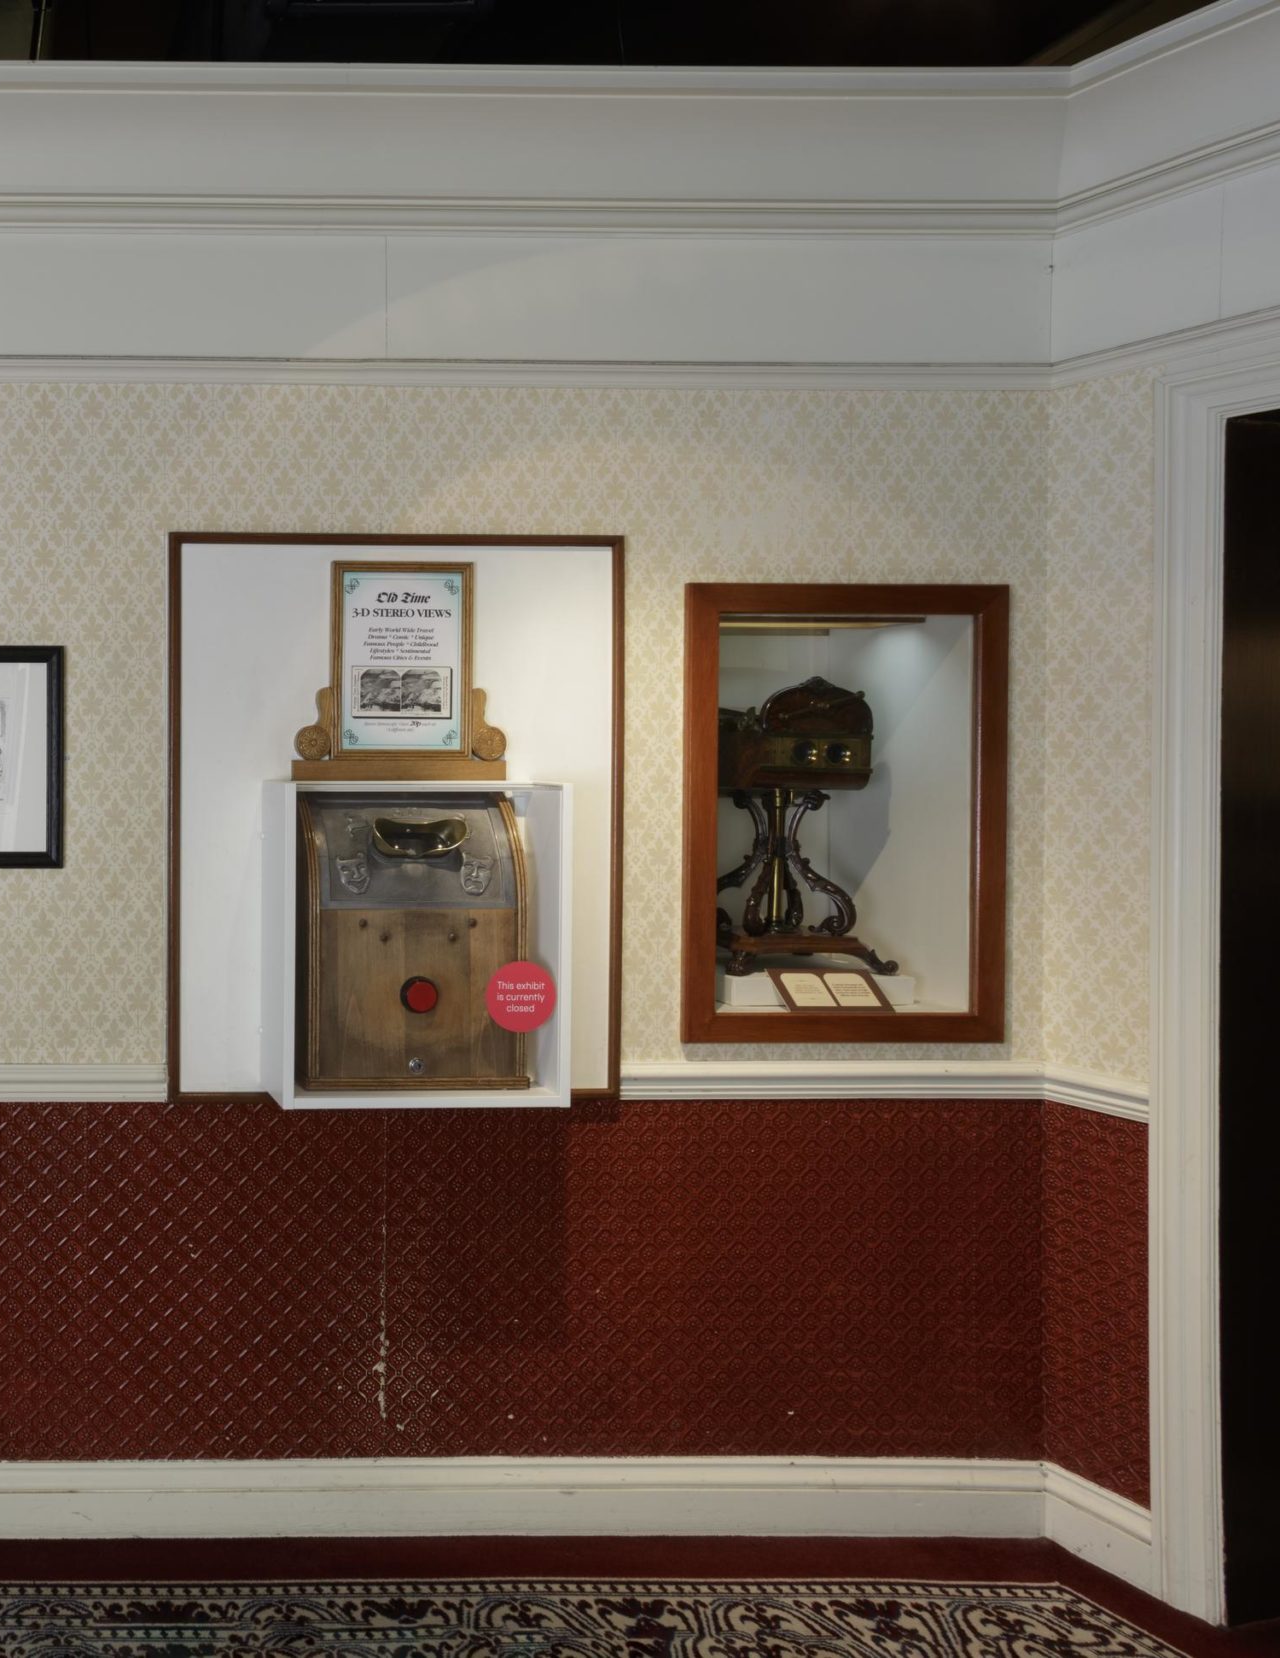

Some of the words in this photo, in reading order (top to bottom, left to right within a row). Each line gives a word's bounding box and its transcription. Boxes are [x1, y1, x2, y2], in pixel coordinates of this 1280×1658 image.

[376, 592, 398, 603] Old
[401, 592, 431, 603] Time
[352, 608, 370, 618] 3-D
[372, 608, 415, 618] STEREO
[417, 608, 452, 618] VIEWS
[498, 981, 513, 990] This
[516, 981, 545, 990] exhibit
[497, 992, 504, 1001] is
[506, 993, 545, 1004] currently
[506, 1004, 535, 1012] closed
